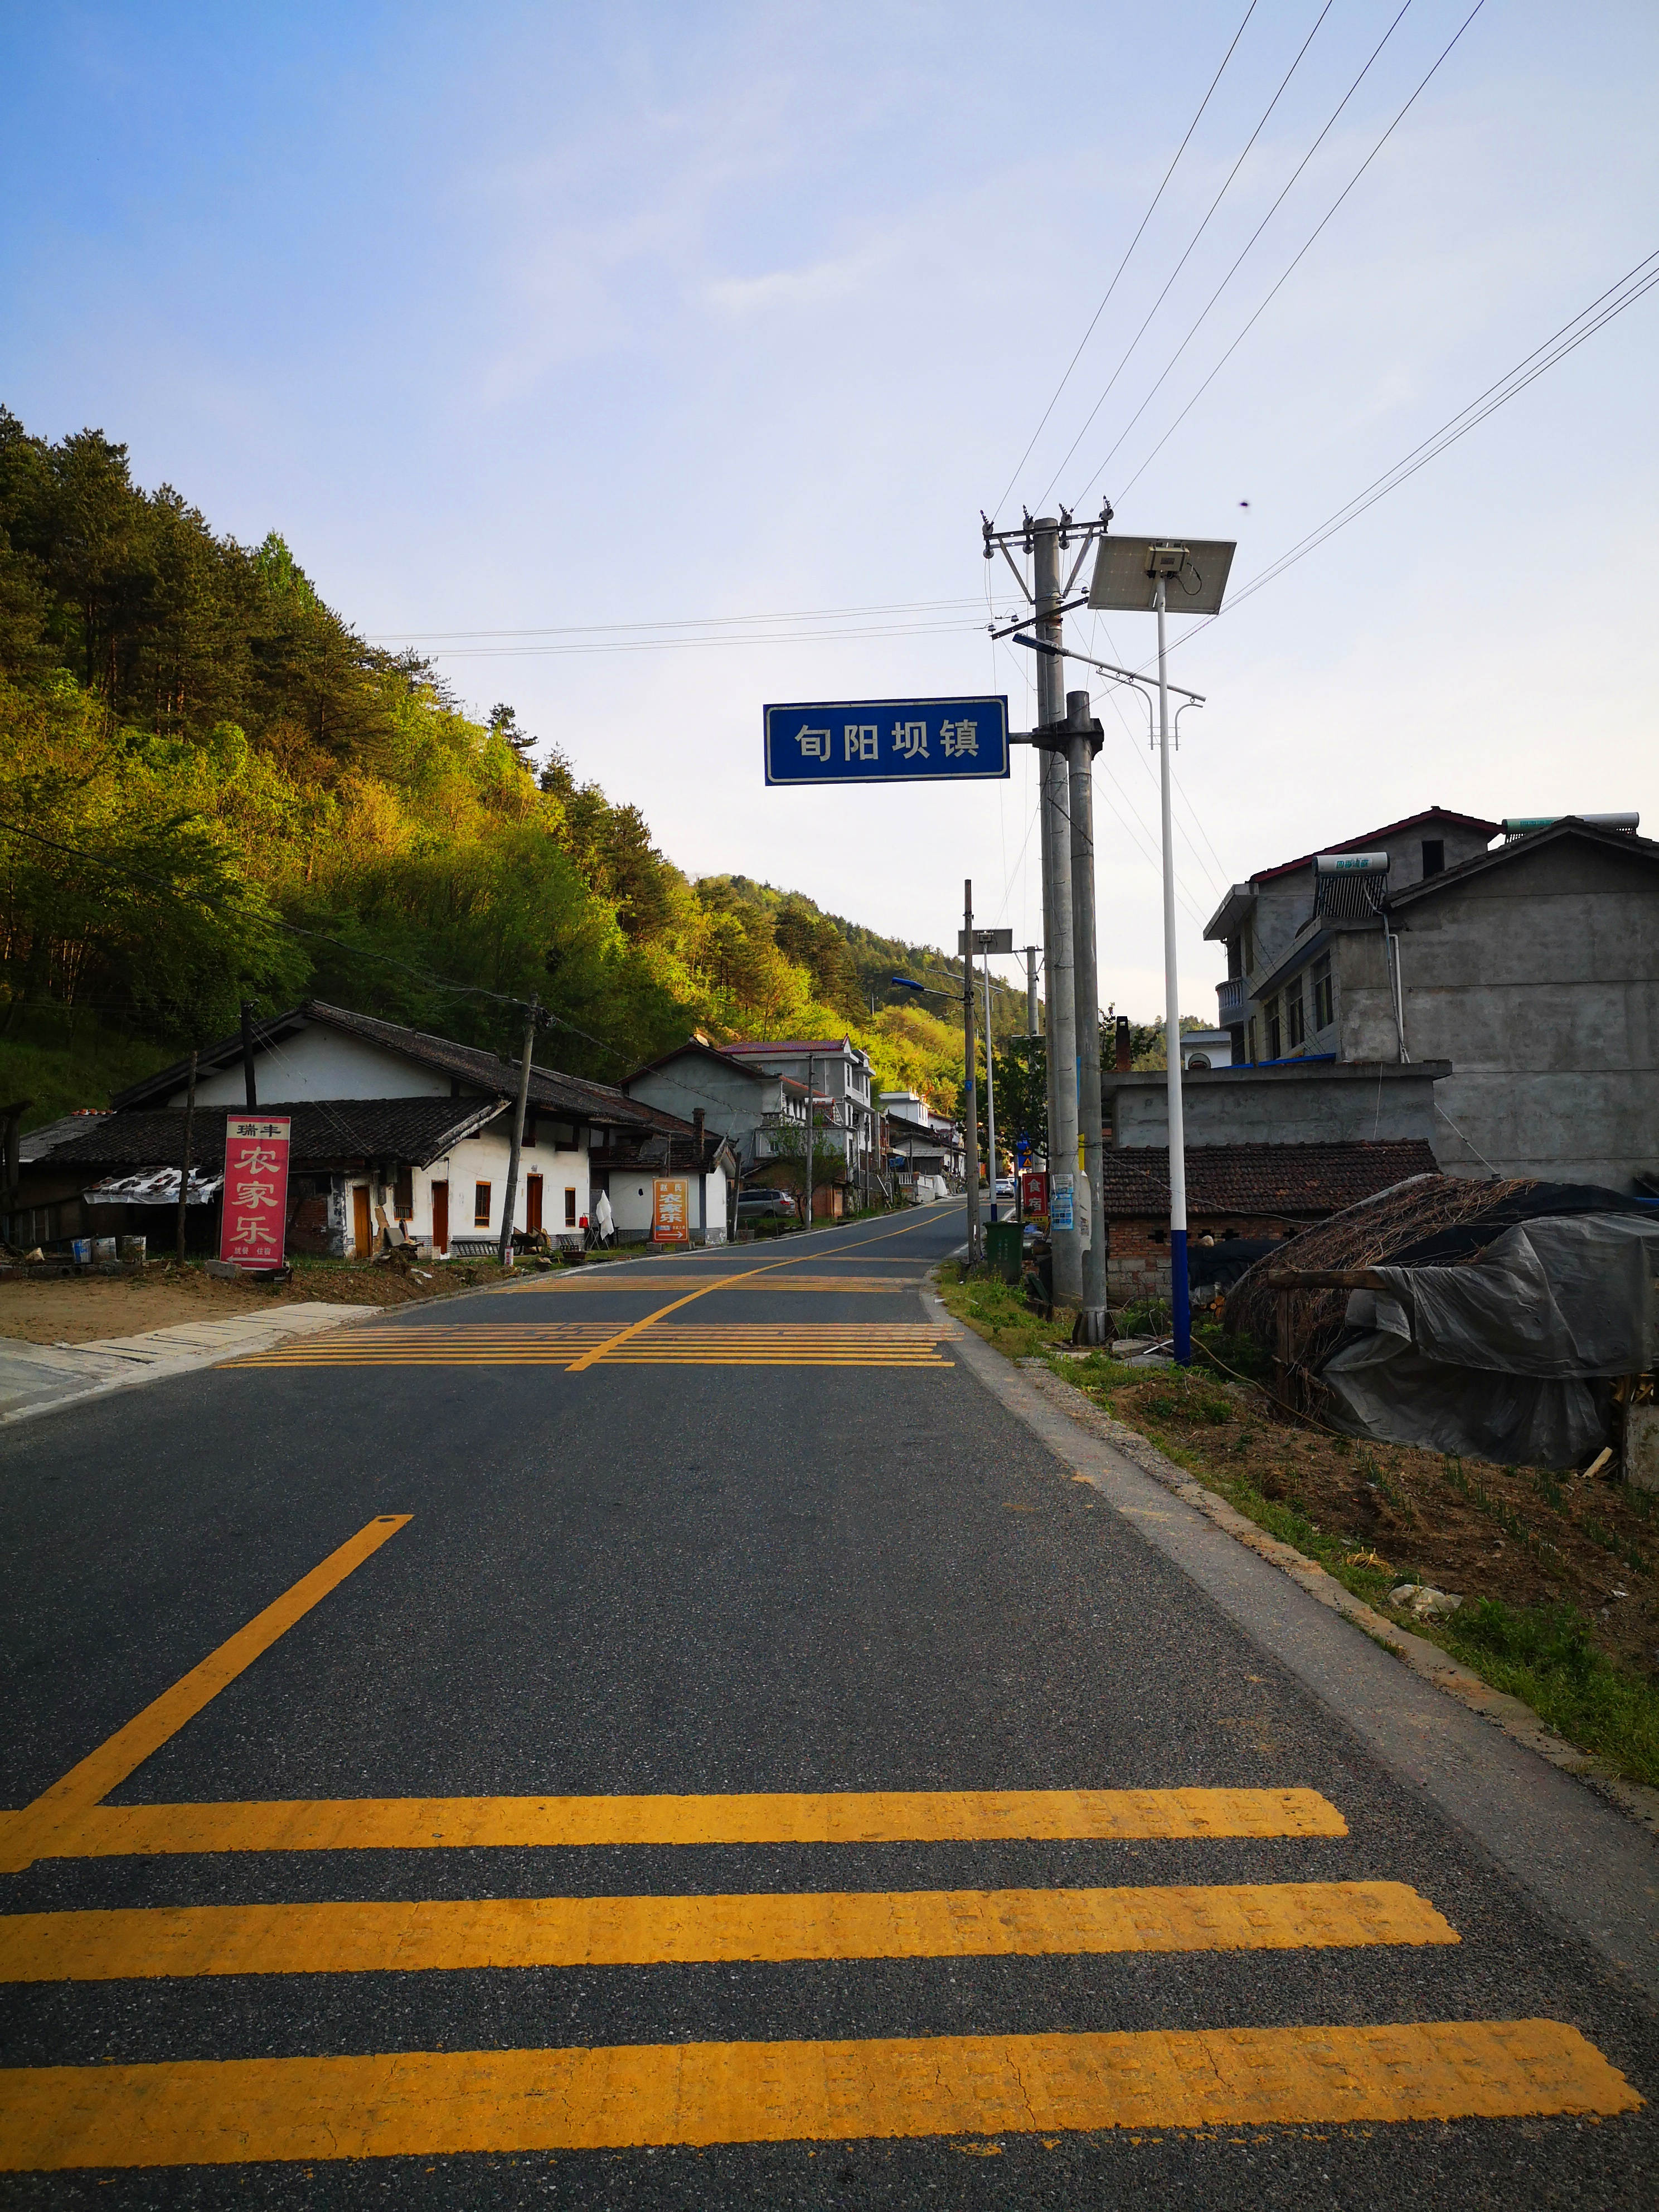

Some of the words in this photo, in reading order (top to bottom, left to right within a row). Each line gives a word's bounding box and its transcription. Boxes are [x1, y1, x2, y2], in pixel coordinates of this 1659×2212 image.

[794, 719, 979, 761] 旬阳坝镇
[236, 1124, 282, 1138] 瑞丰
[229, 1146, 281, 1244] 农家乐
[658, 1194, 683, 1223] 农家乐
[1027, 1178, 1042, 1211] 食宿
